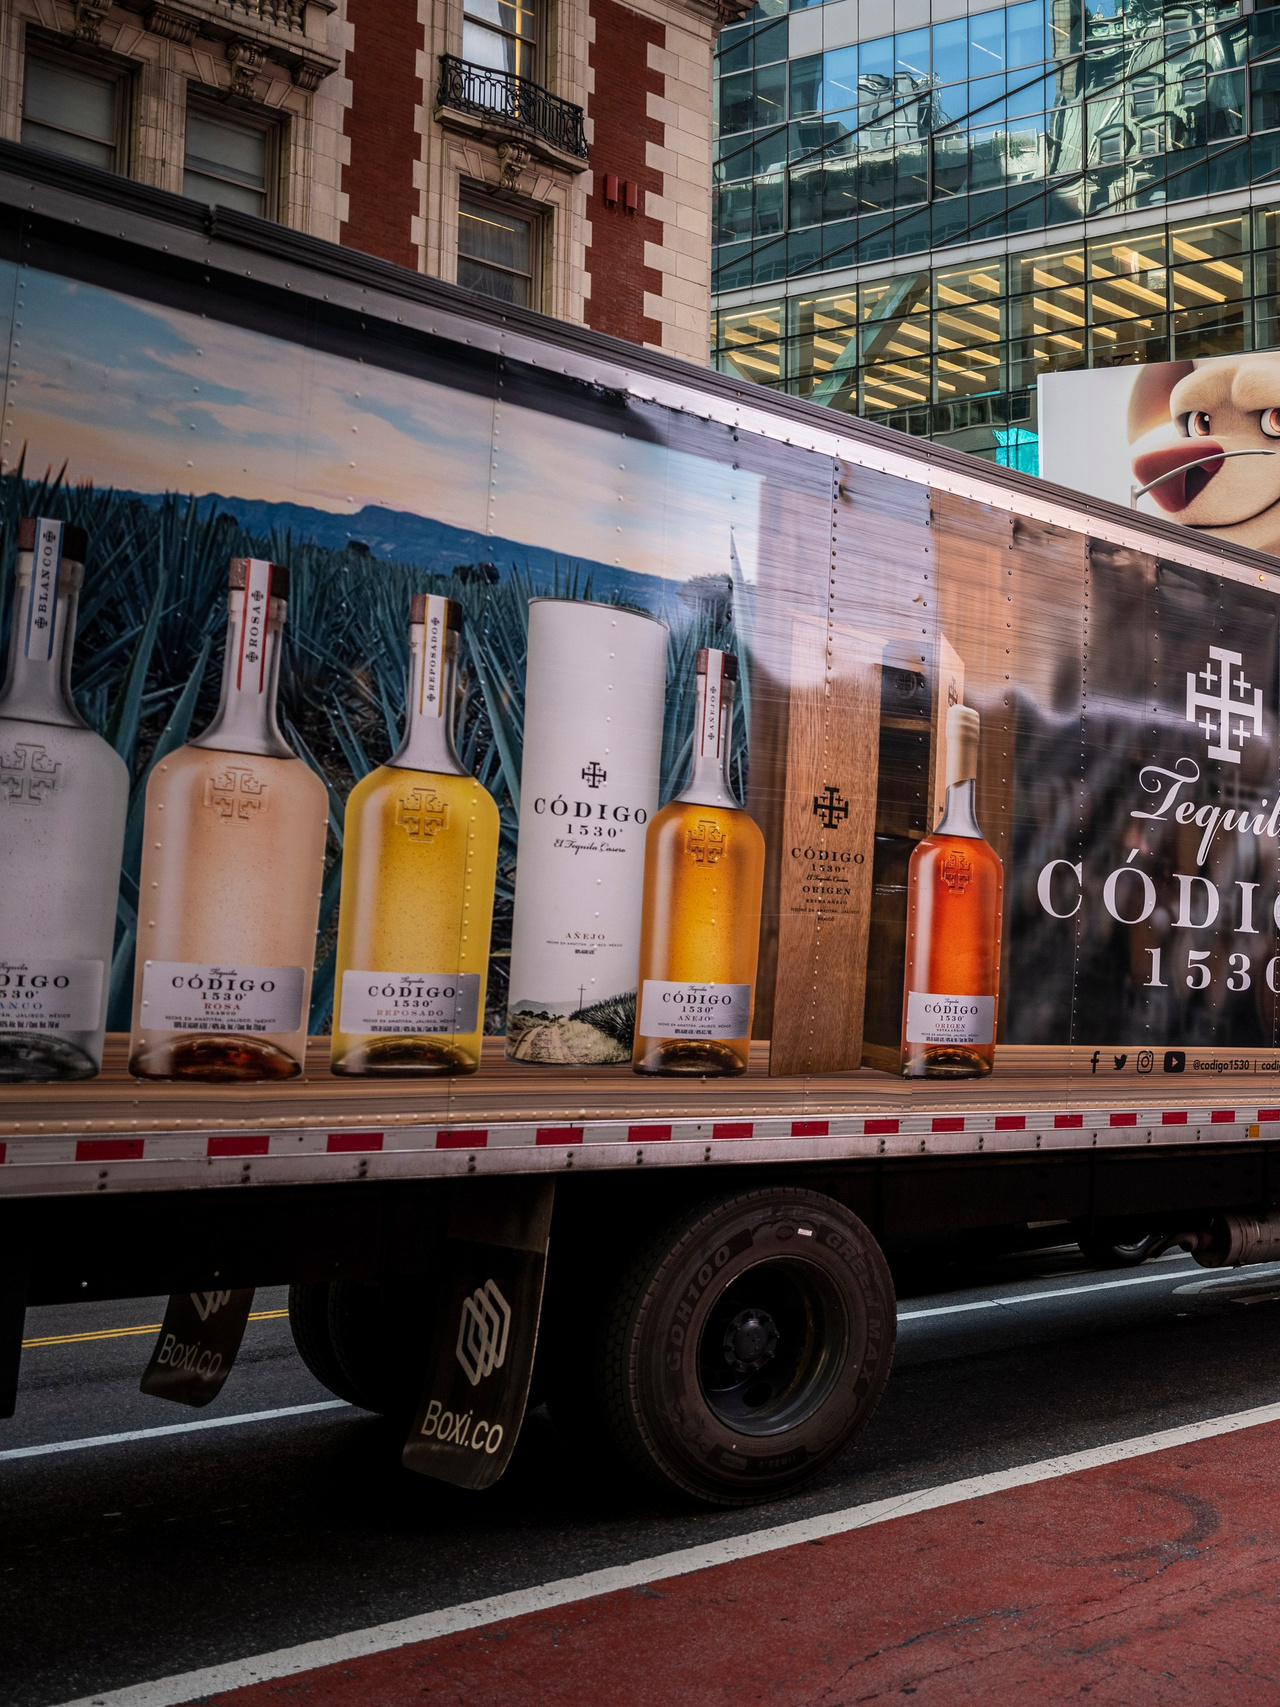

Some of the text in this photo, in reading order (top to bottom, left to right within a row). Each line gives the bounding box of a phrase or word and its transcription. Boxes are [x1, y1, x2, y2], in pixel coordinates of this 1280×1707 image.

[38, 546, 54, 614] BLANCO
[249, 604, 262, 648] ROSA
[429, 627, 440, 692] REPOSADO
[534, 794, 647, 825] CÓDIGO
[554, 839, 562, 849] El
[564, 840, 598, 855] Tequila
[791, 846, 865, 865] CÓDIGO
[802, 885, 851, 896] ORIGEN
[566, 931, 605, 941] AÑEJO
[209, 967, 238, 979] Tequila
[172, 974, 275, 993] CÓDIGO
[400, 976, 425, 986] Tequila
[368, 983, 456, 998] CÓDIGO
[662, 991, 732, 1005] CÓDIGO
[204, 1002, 241, 1010] ROSA
[377, 1009, 444, 1017] REPOSADO
[924, 1002, 978, 1015] CÓDIGO
[1193, 1059, 1249, 1073] @codigo1530
[157, 1332, 223, 1378] Boxi.co
[421, 1400, 503, 1454] Boxi.co
